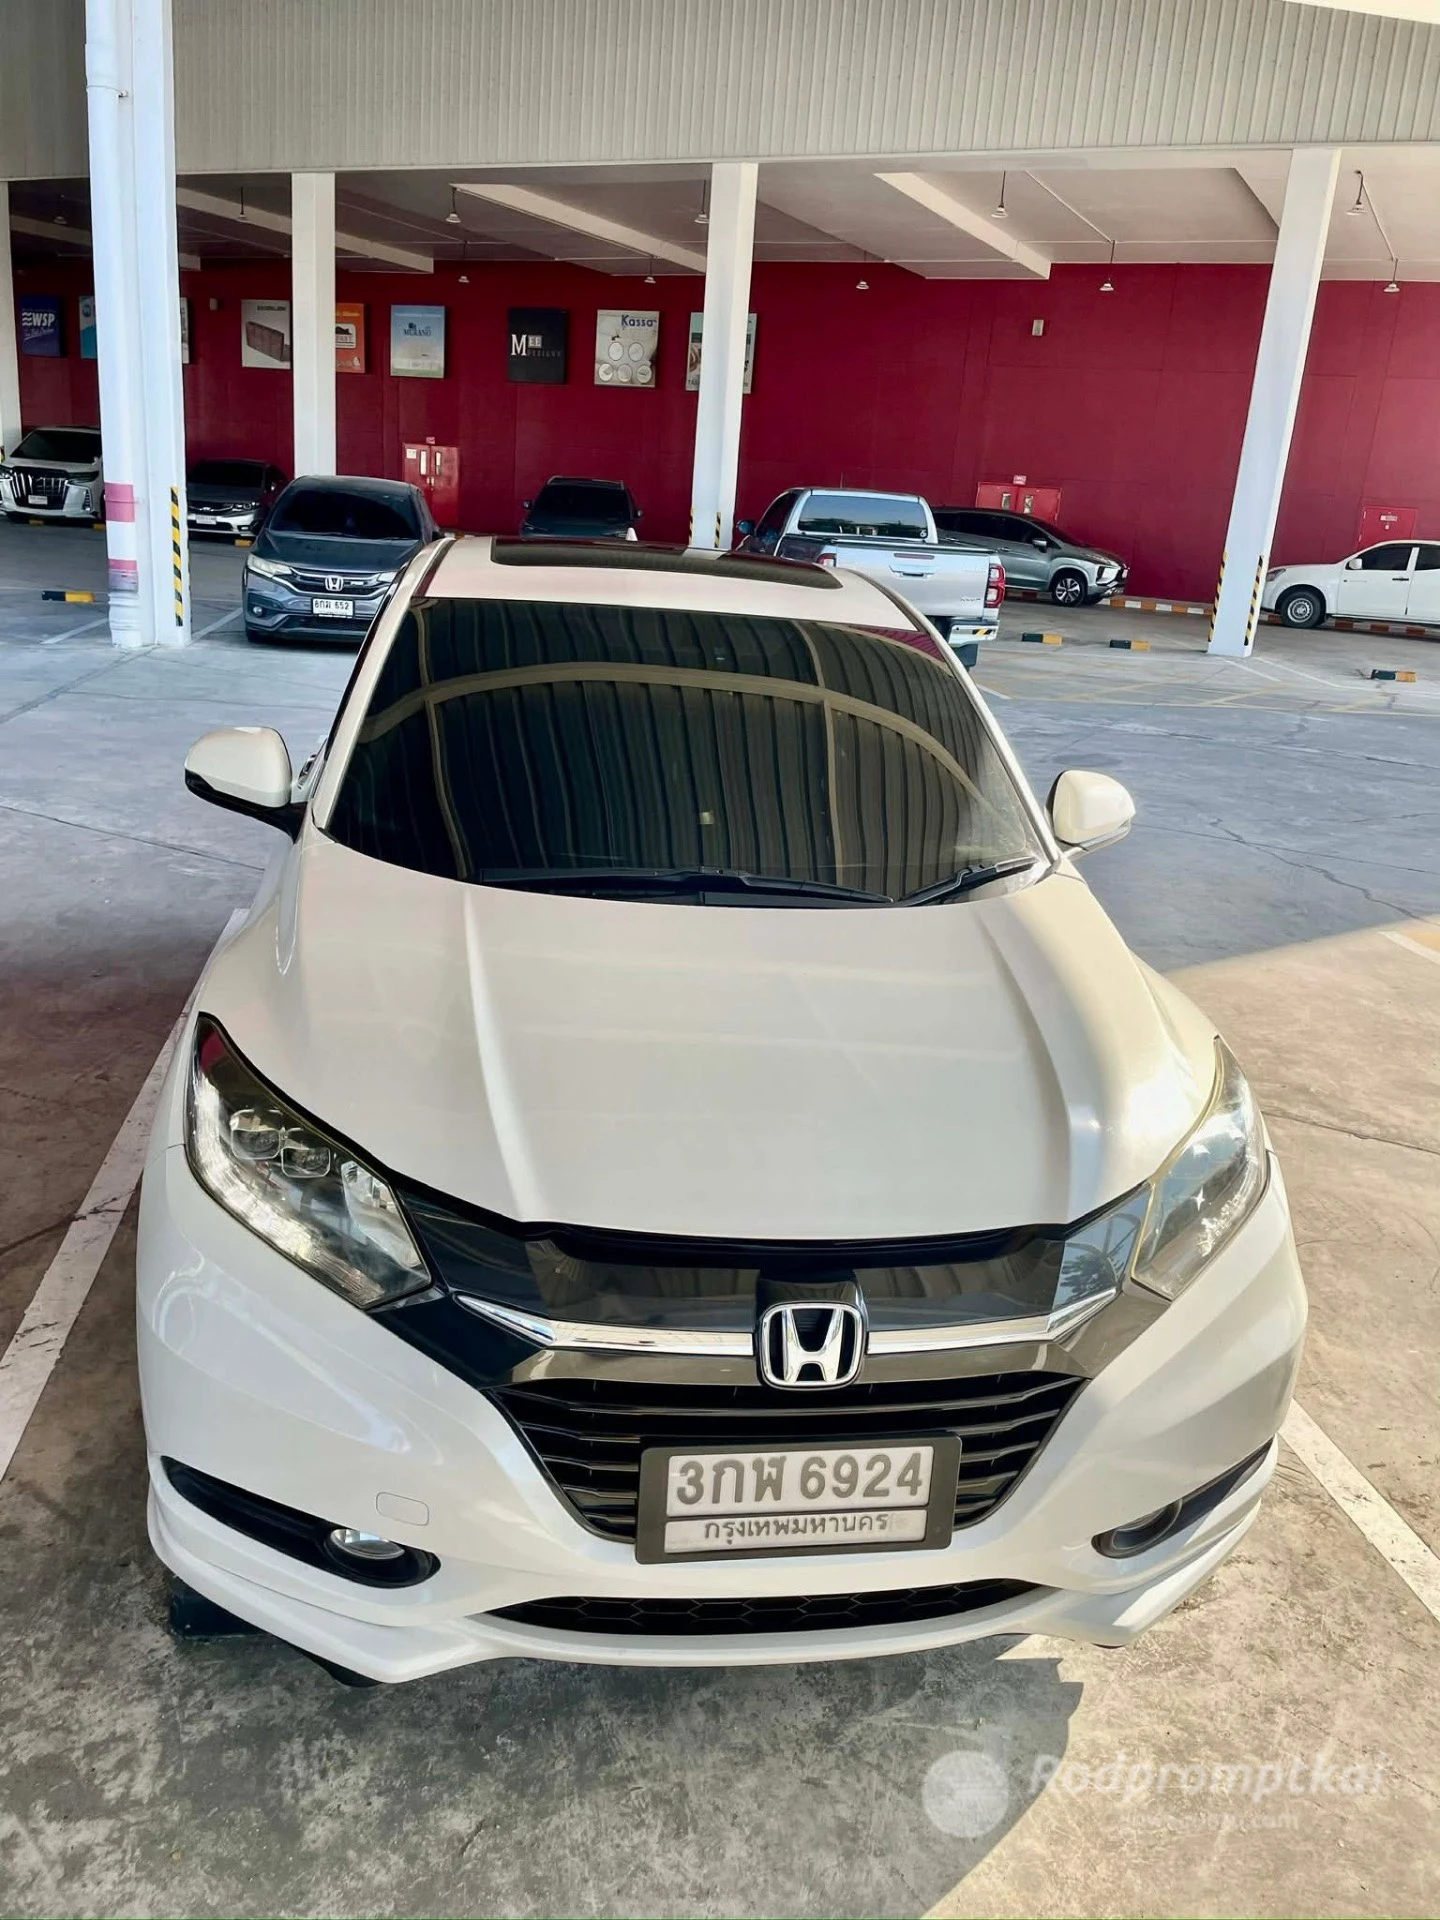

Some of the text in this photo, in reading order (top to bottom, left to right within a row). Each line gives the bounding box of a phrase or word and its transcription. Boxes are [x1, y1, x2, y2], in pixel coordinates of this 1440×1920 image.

[32, 312, 56, 327] WSP
[621, 314, 653, 328] Kassa
[799, 1452, 922, 1501] 6924
[704, 1512, 888, 1546] กรุงเทพมหานคร
